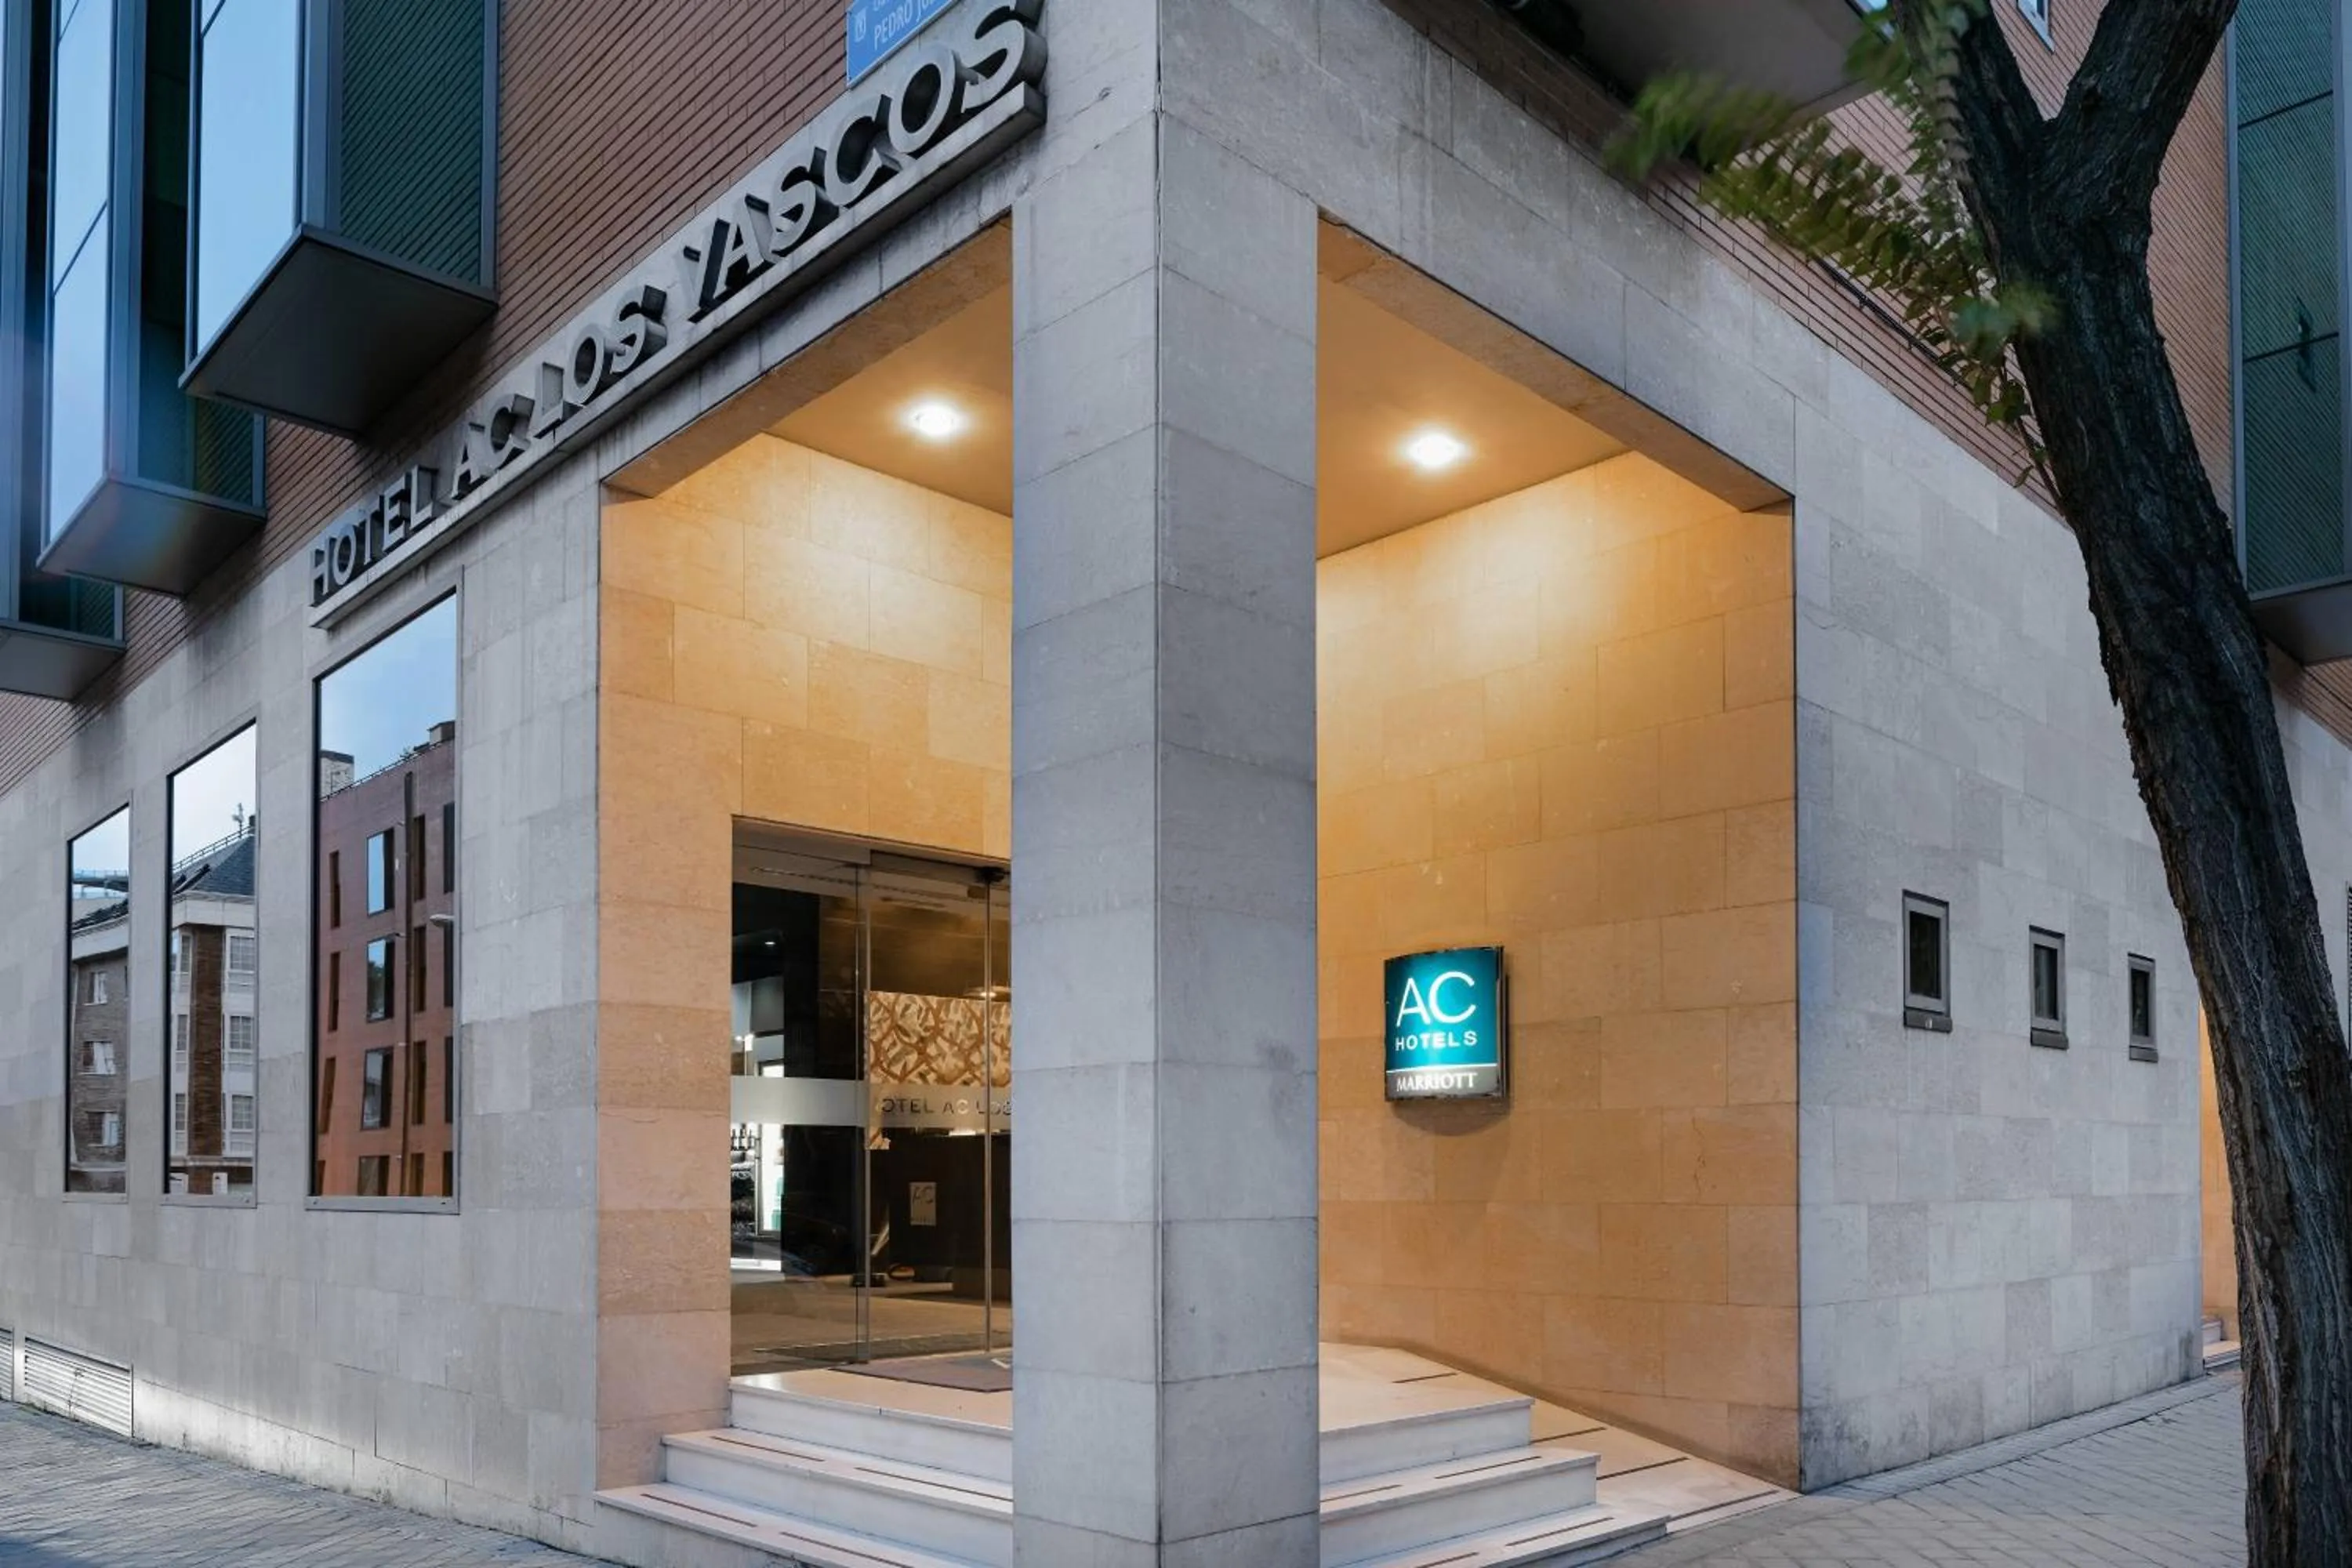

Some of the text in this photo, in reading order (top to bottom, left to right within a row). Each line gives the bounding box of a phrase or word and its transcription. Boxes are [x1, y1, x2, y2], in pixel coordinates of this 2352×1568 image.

[873, 0, 913, 51] PEDRO
[309, 464, 441, 604] HOTEL
[450, 392, 524, 502] AC
[532, 285, 655, 439] LOS
[1396, 971, 1477, 1028] AC
[1395, 1030, 1479, 1052] HOTELS
[1396, 1072, 1478, 1092] MARRIOTT
